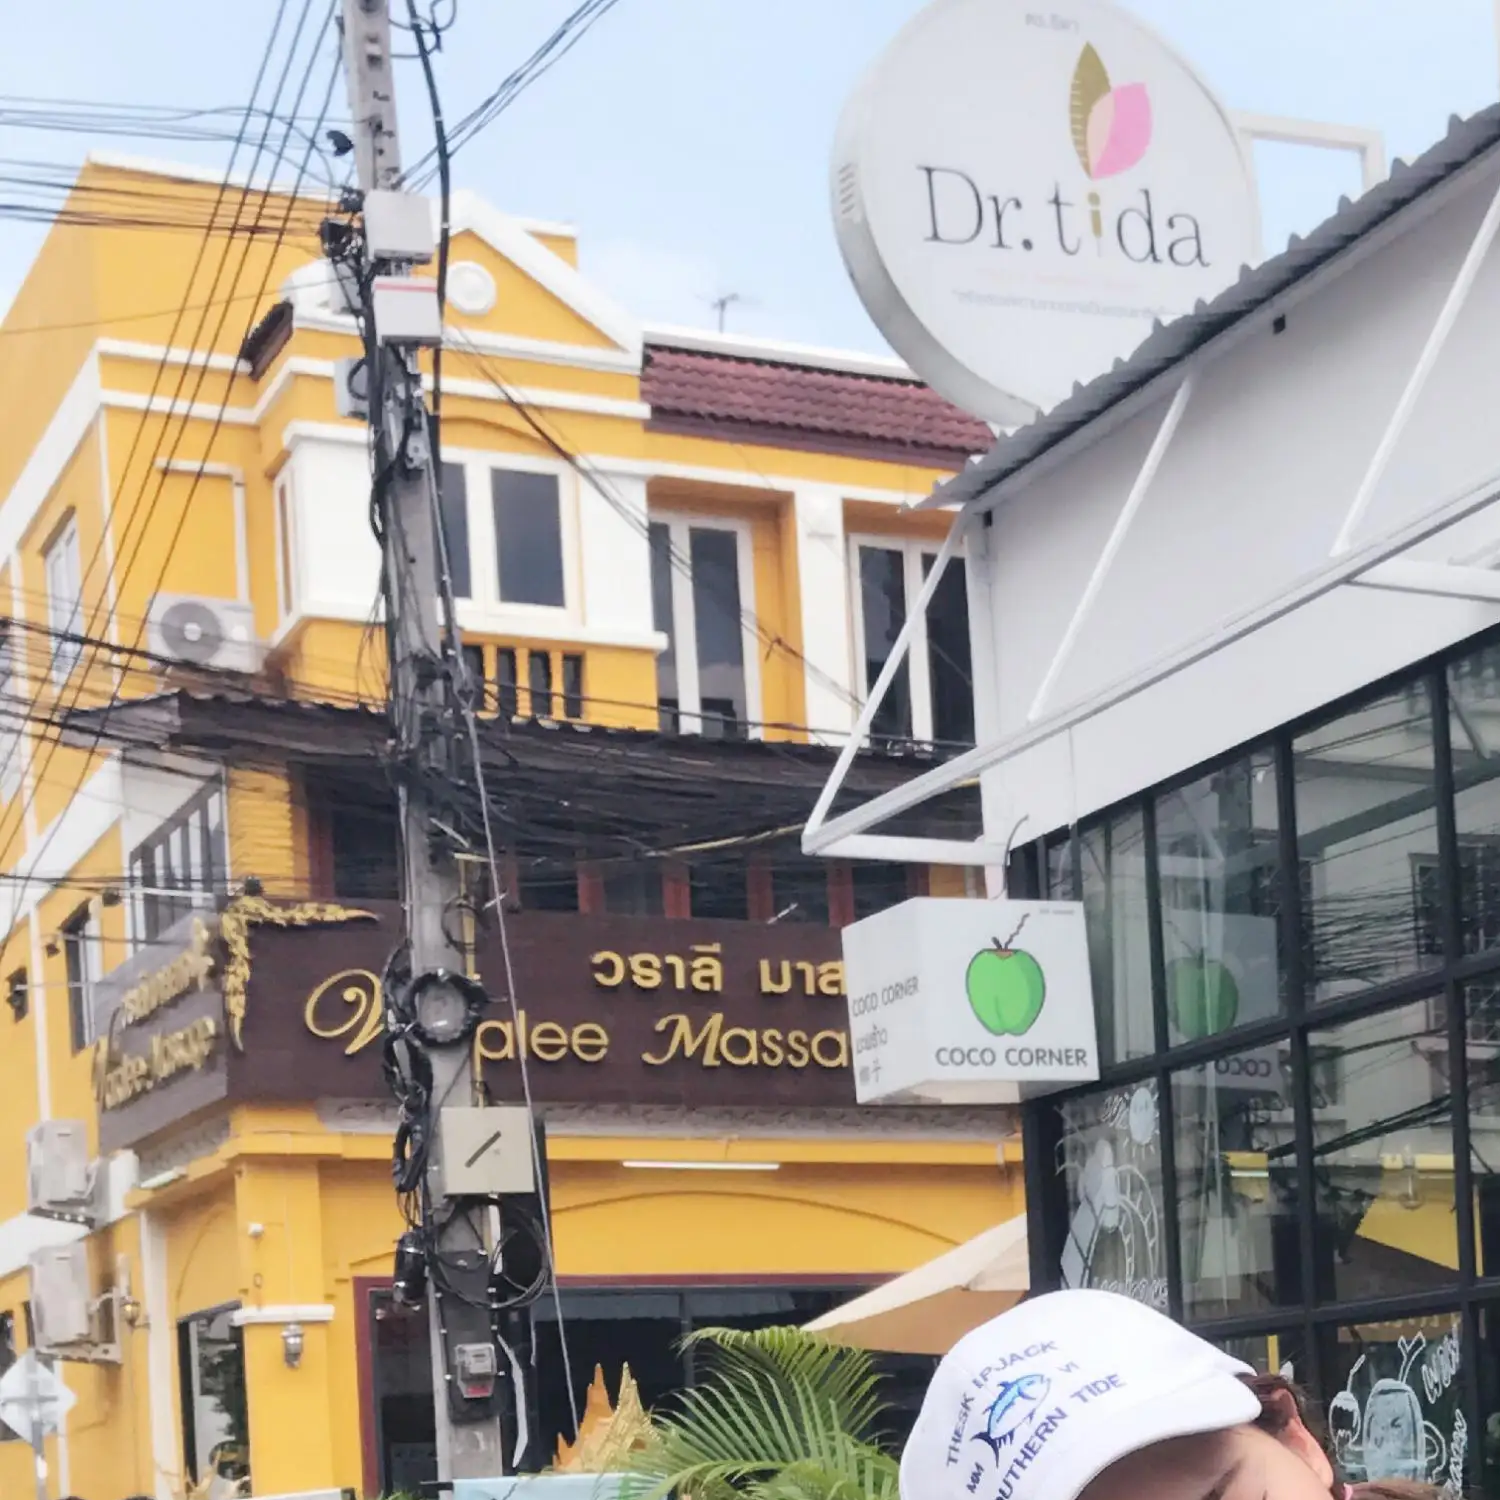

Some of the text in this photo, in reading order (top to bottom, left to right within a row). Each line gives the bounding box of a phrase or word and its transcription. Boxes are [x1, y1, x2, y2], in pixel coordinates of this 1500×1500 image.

[852, 992, 878, 1017] COCO
[935, 1047, 1088, 1067] COCO CORNER
[1070, 1373, 1127, 1403] TIDE
